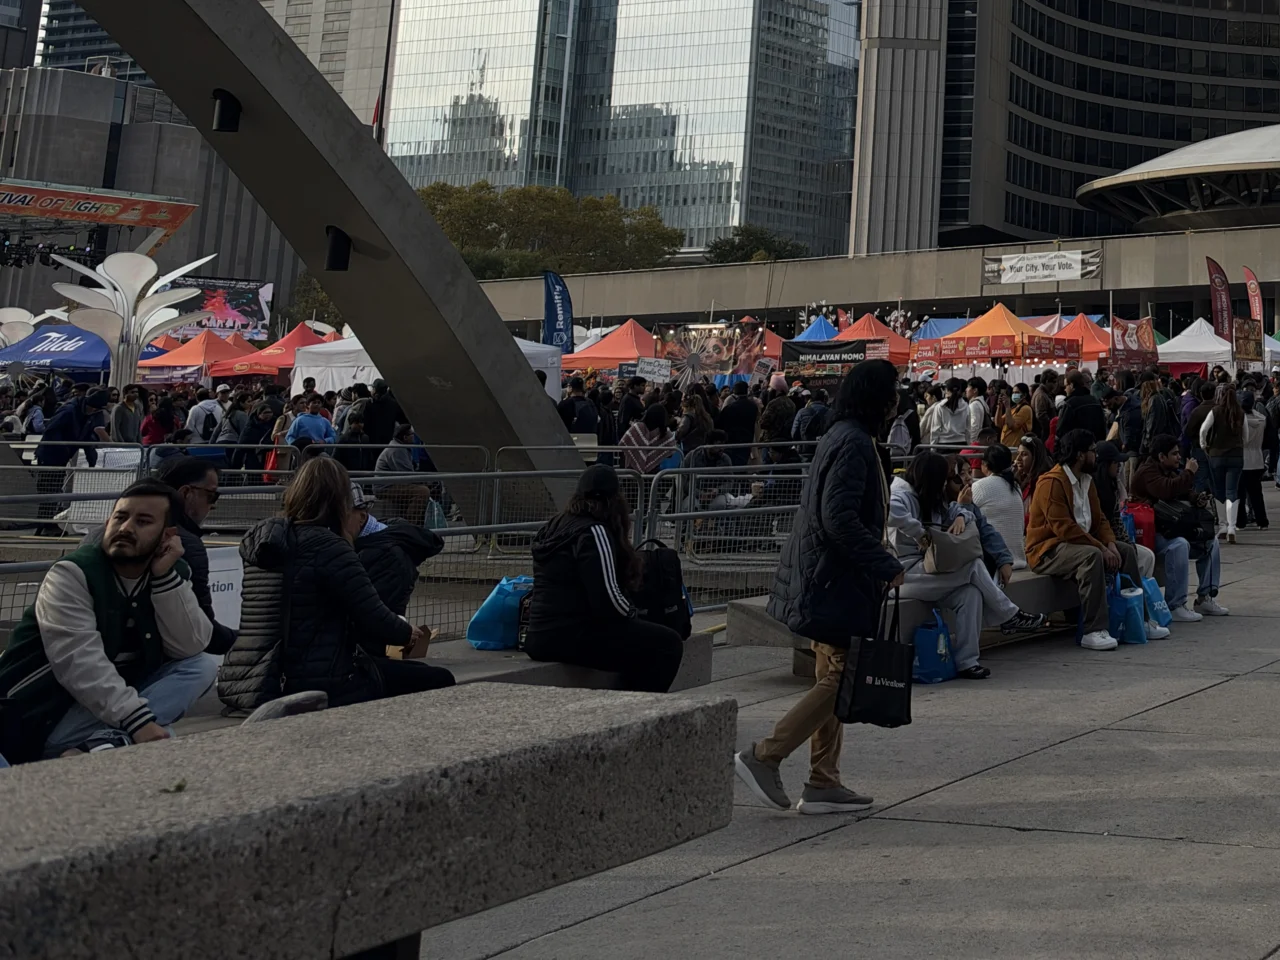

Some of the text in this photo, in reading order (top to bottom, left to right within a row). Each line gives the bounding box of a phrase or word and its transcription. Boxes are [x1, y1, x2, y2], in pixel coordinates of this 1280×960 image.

[38, 197, 65, 209] OF
[62, 199, 122, 217] LIGHTS
[1009, 264, 1024, 274] Your
[1025, 263, 1040, 274] City.
[1041, 261, 1057, 272] Your
[1057, 260, 1075, 271] Vote.
[553, 285, 564, 329] Remitly
[28, 332, 87, 352] Tilda
[799, 352, 864, 362] HIMALAYAN MOMO
